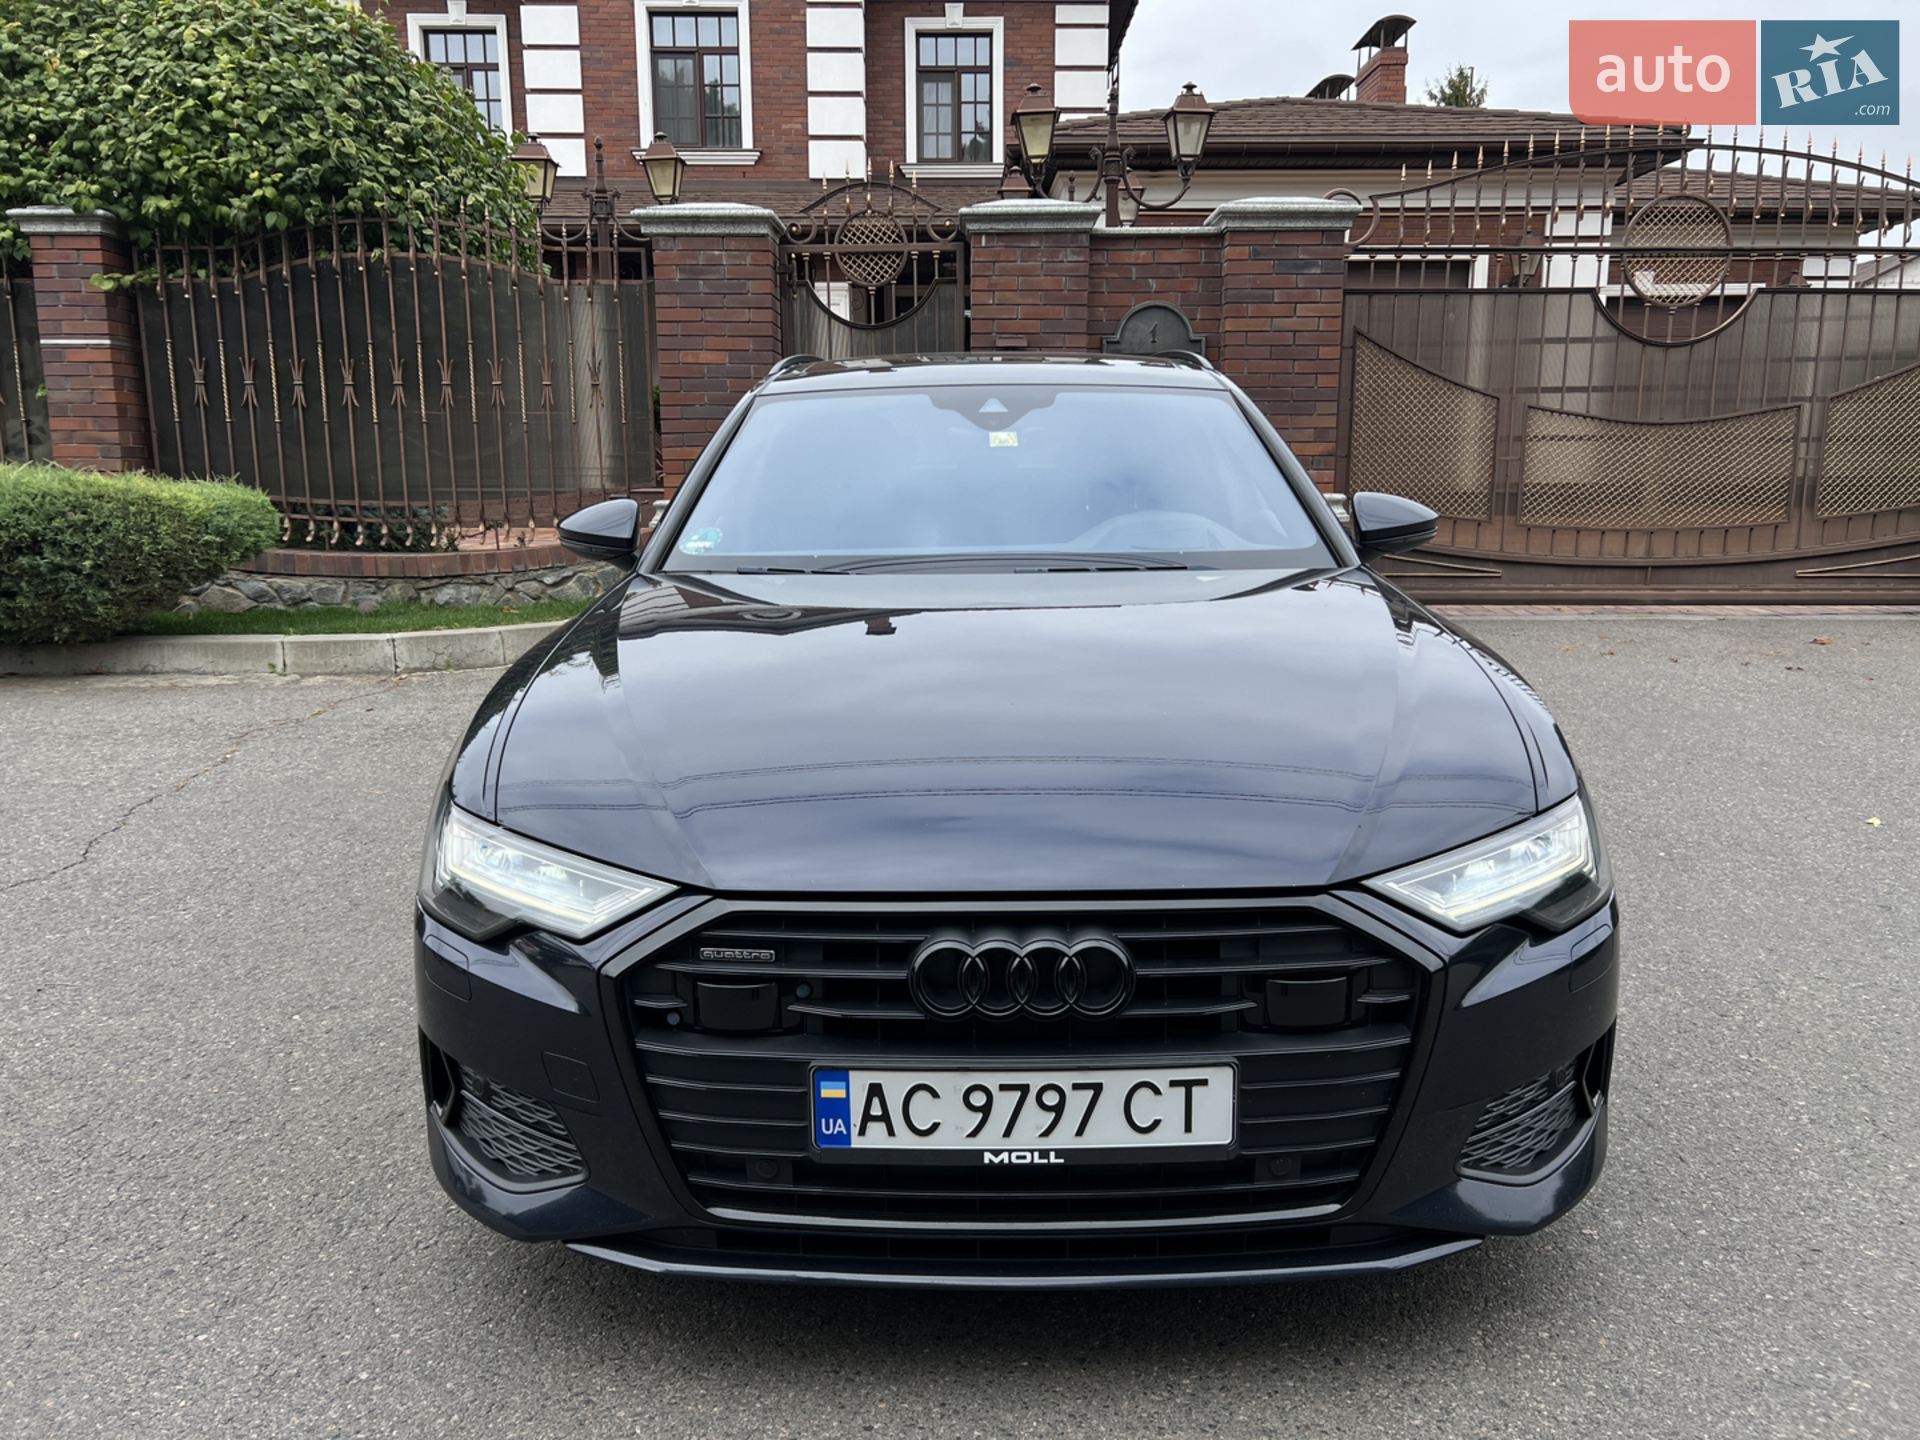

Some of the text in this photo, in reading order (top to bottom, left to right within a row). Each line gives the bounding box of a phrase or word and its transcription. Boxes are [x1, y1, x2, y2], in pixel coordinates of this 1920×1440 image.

[1149, 321, 1158, 343] 1
[702, 950, 772, 960] quattro
[856, 1078, 1209, 1138] AC 9797 CT
[821, 1118, 847, 1135] UA
[983, 1151, 1064, 1164] MOLL
